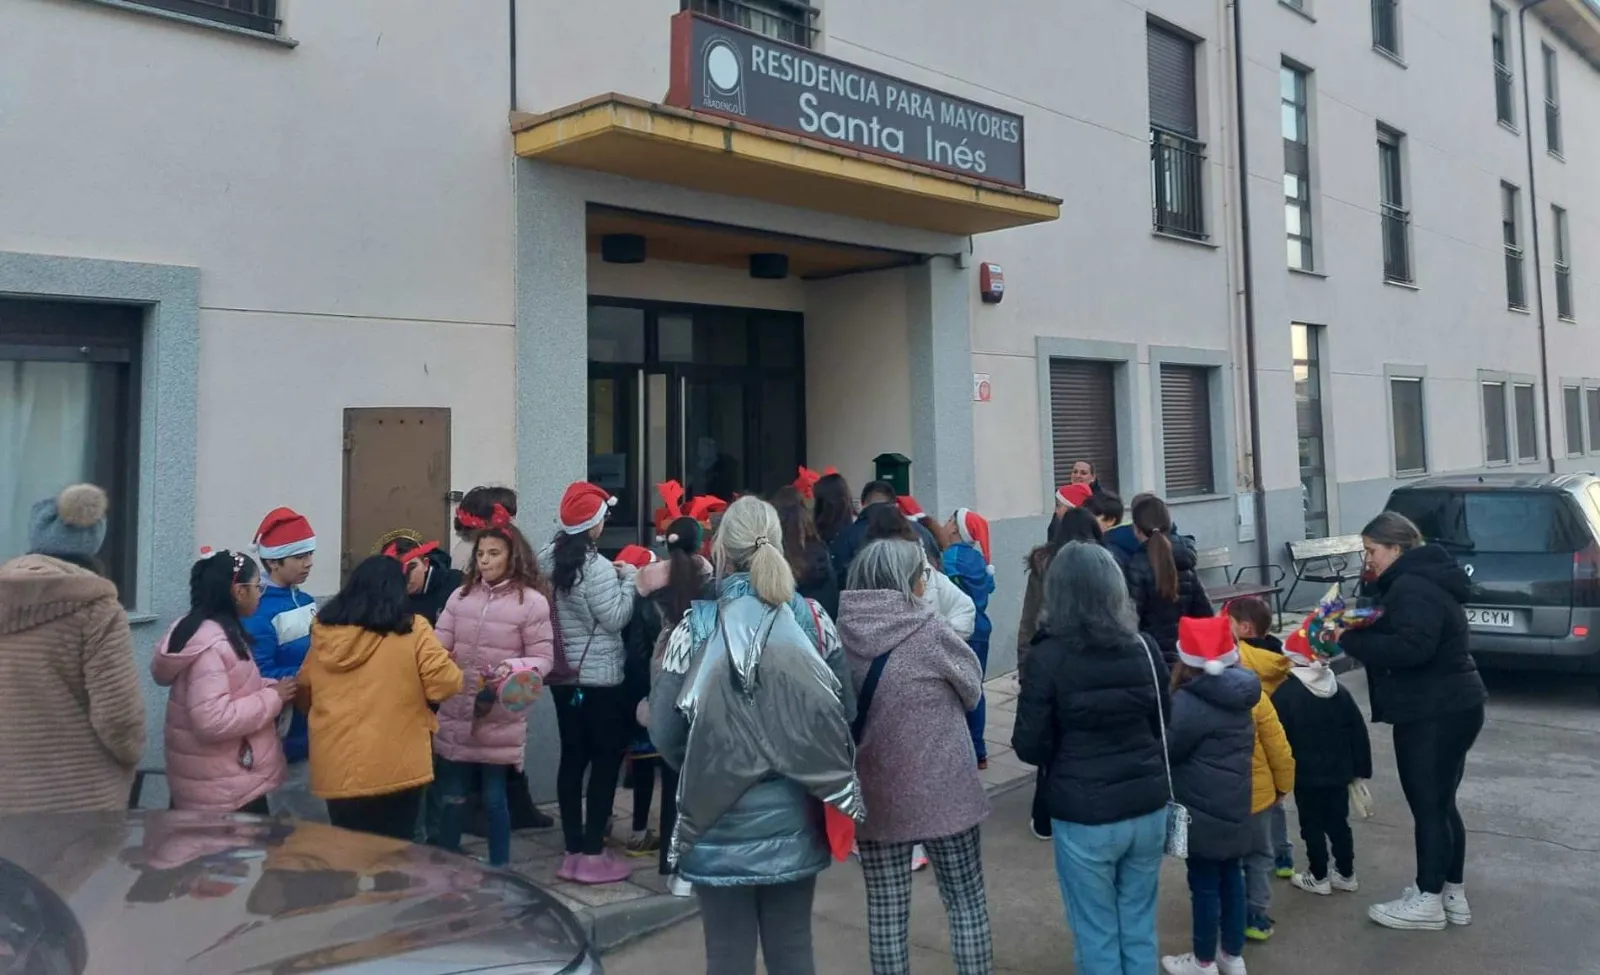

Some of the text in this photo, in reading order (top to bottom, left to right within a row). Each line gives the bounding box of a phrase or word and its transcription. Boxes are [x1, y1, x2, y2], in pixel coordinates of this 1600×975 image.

[751, 45, 880, 106] RESIDENCIA
[886, 86, 935, 120] PARA
[940, 106, 1019, 143] MAYORES
[799, 93, 987, 173] Santa Inés
[1481, 611, 1510, 625] CYM
